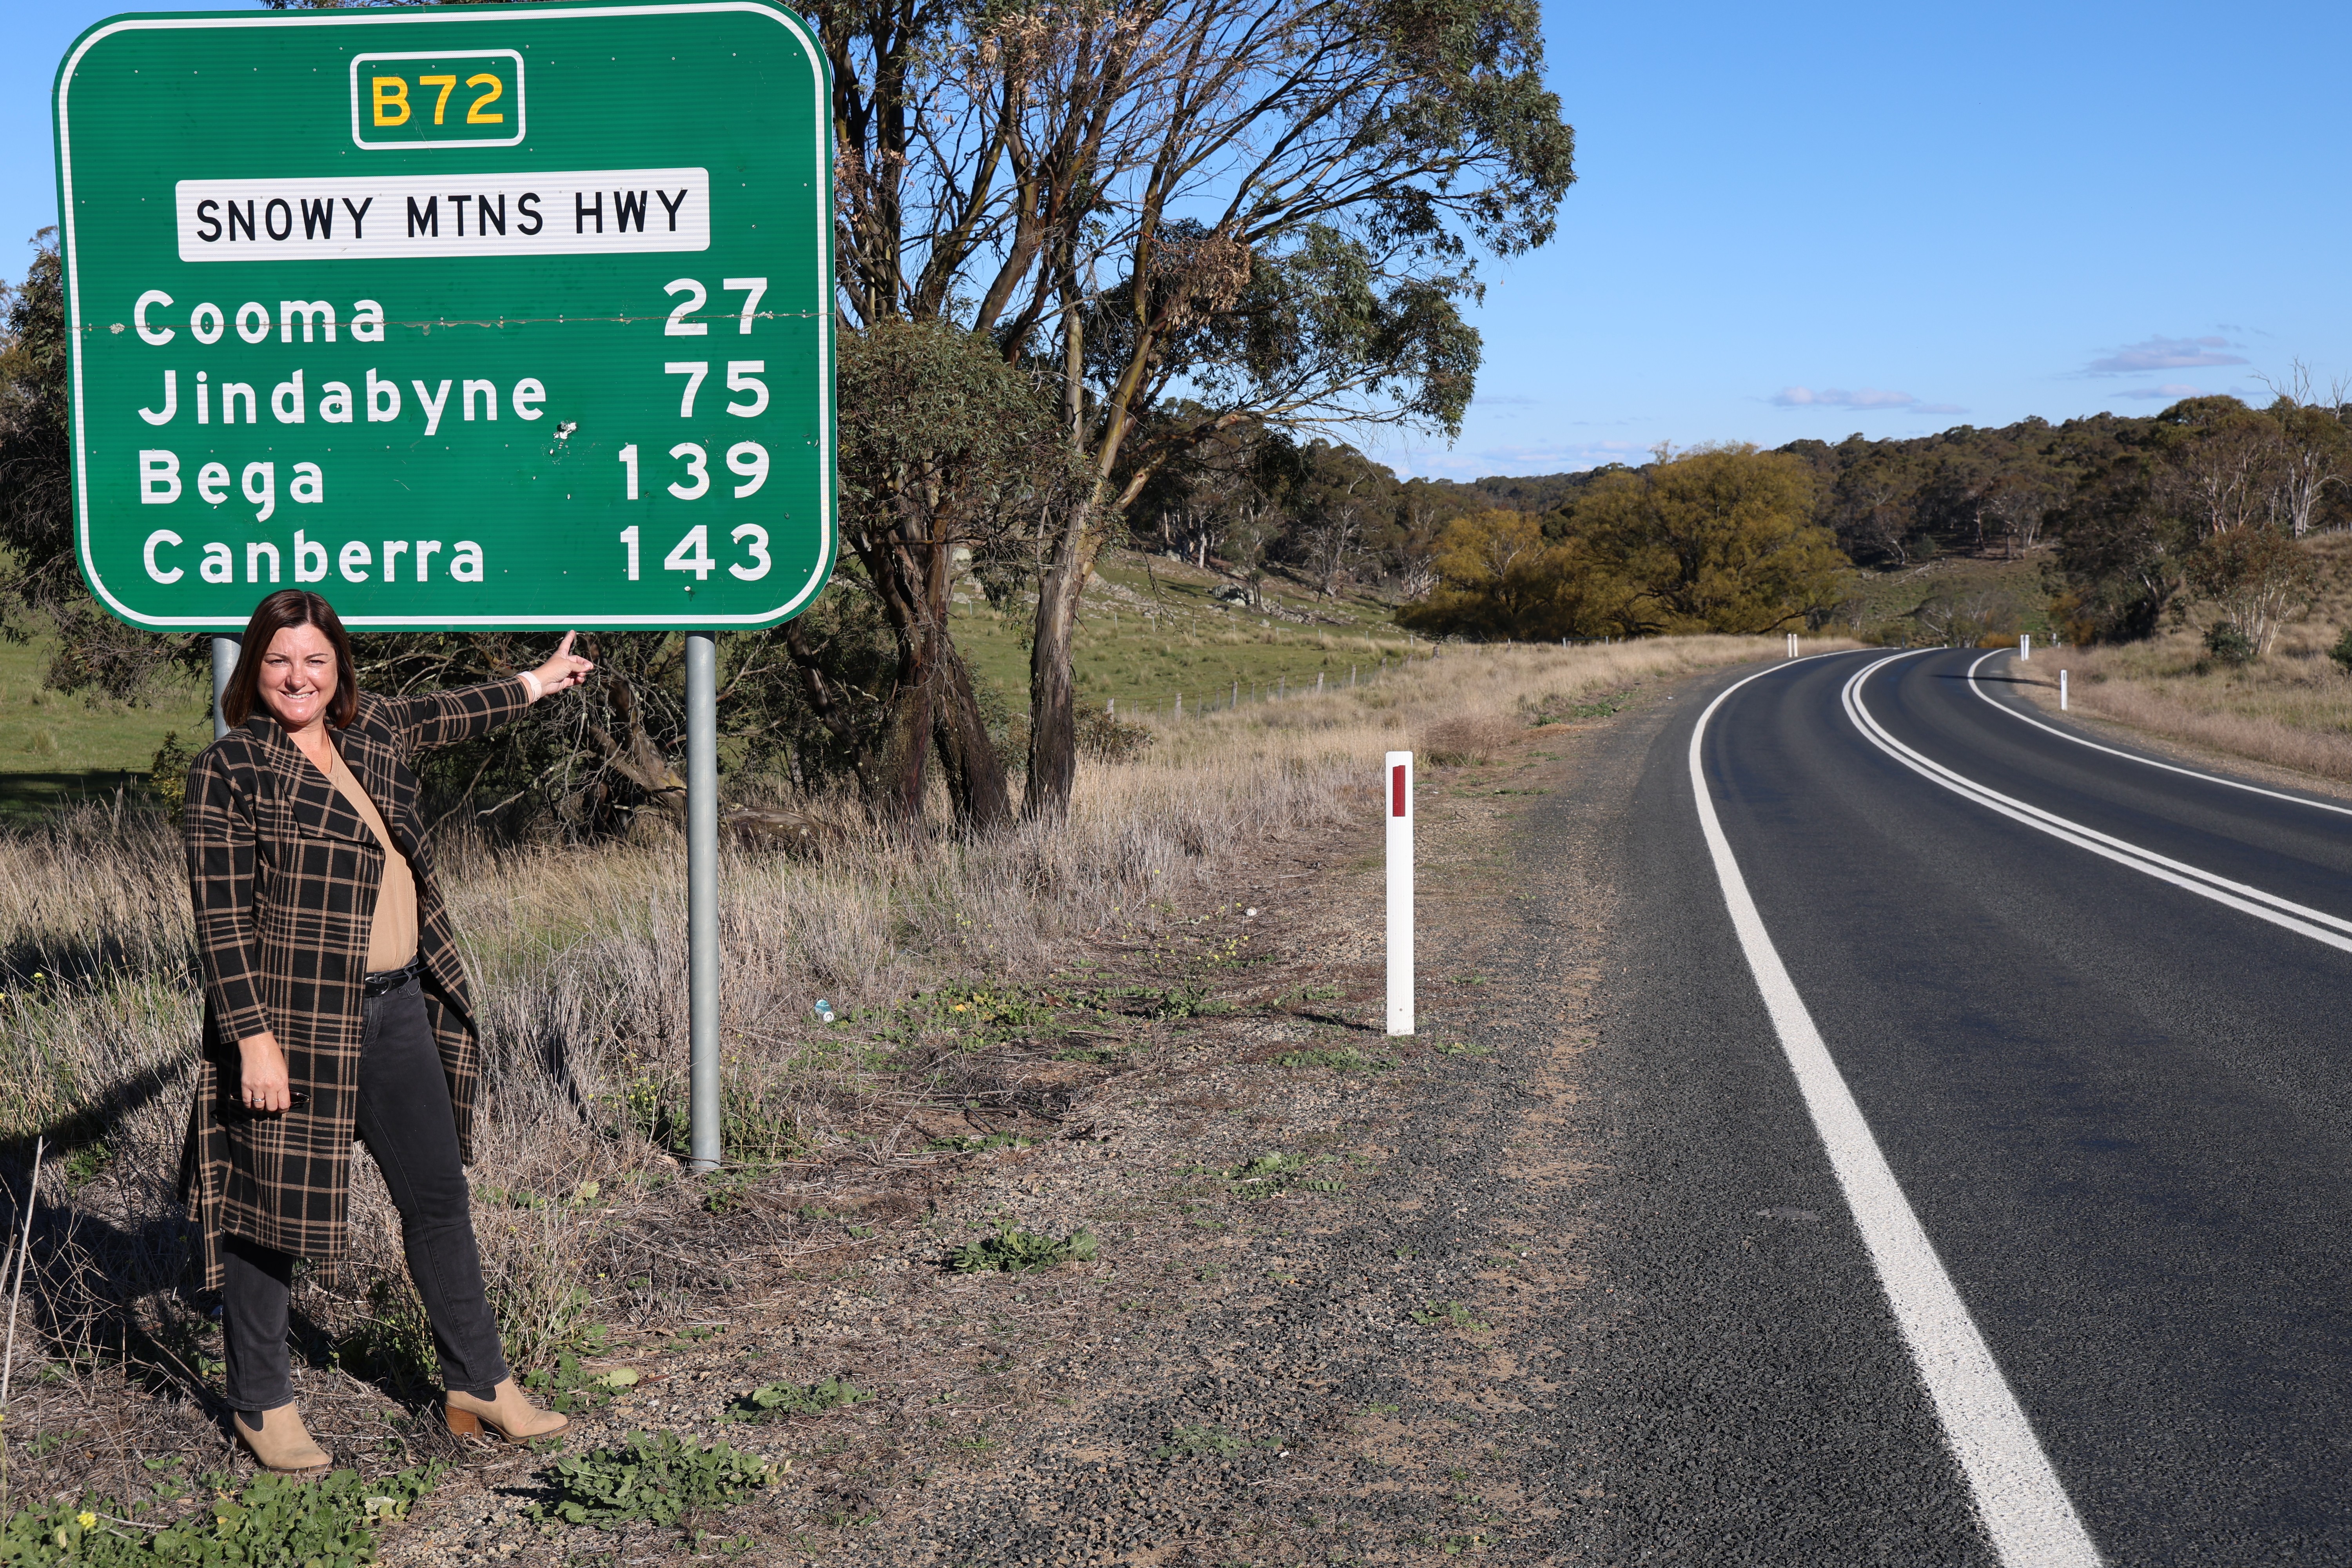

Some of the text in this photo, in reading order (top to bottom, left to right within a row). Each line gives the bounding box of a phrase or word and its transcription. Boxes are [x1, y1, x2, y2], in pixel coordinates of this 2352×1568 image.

[373, 74, 503, 126] B72
[197, 190, 688, 242] SNOWY MTNS HWY
[134, 278, 767, 345] Cooma 27
[138, 361, 769, 435] Jindabyne 75
[140, 442, 769, 522] Bega 139
[144, 523, 771, 584] Canberra 143
